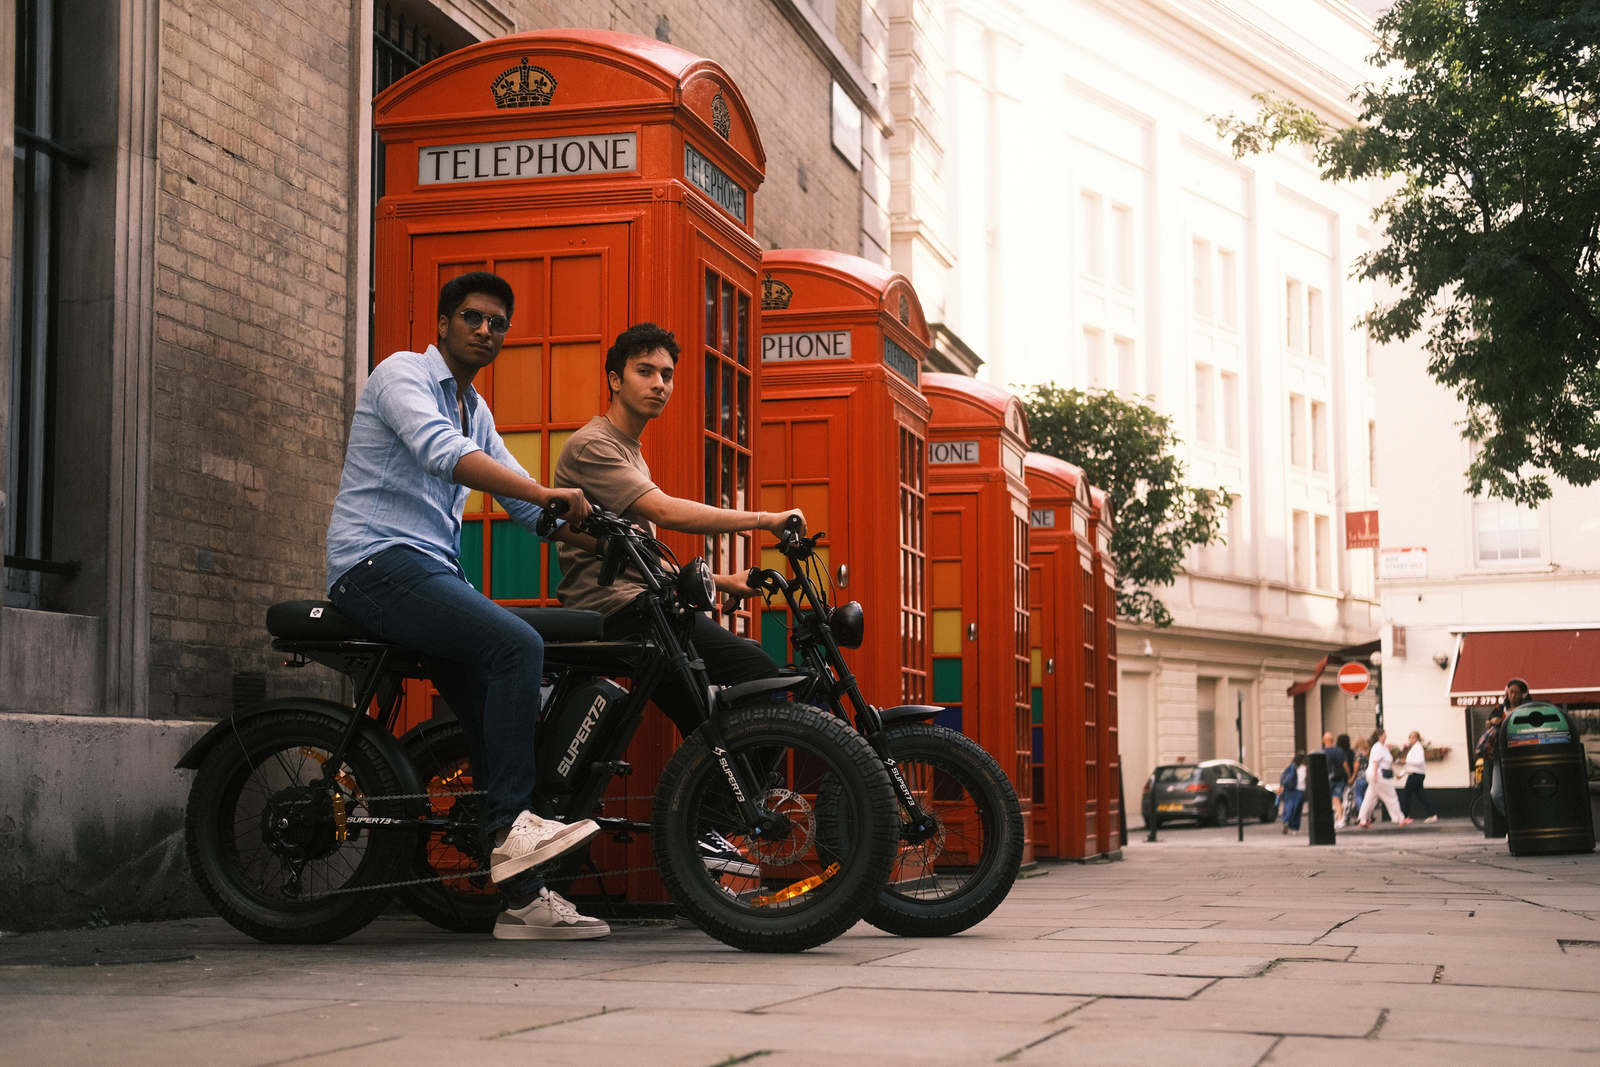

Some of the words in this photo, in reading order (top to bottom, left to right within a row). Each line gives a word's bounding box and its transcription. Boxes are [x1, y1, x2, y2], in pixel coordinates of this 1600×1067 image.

[426, 138, 630, 181] TELEPHONE
[685, 144, 743, 220] TELEPHONE
[762, 333, 846, 359] PHONE
[557, 694, 607, 777] SUPER73
[719, 757, 745, 803] SUPER73
[891, 767, 915, 806] SUPER73
[346, 816, 391, 825] SUPER73
